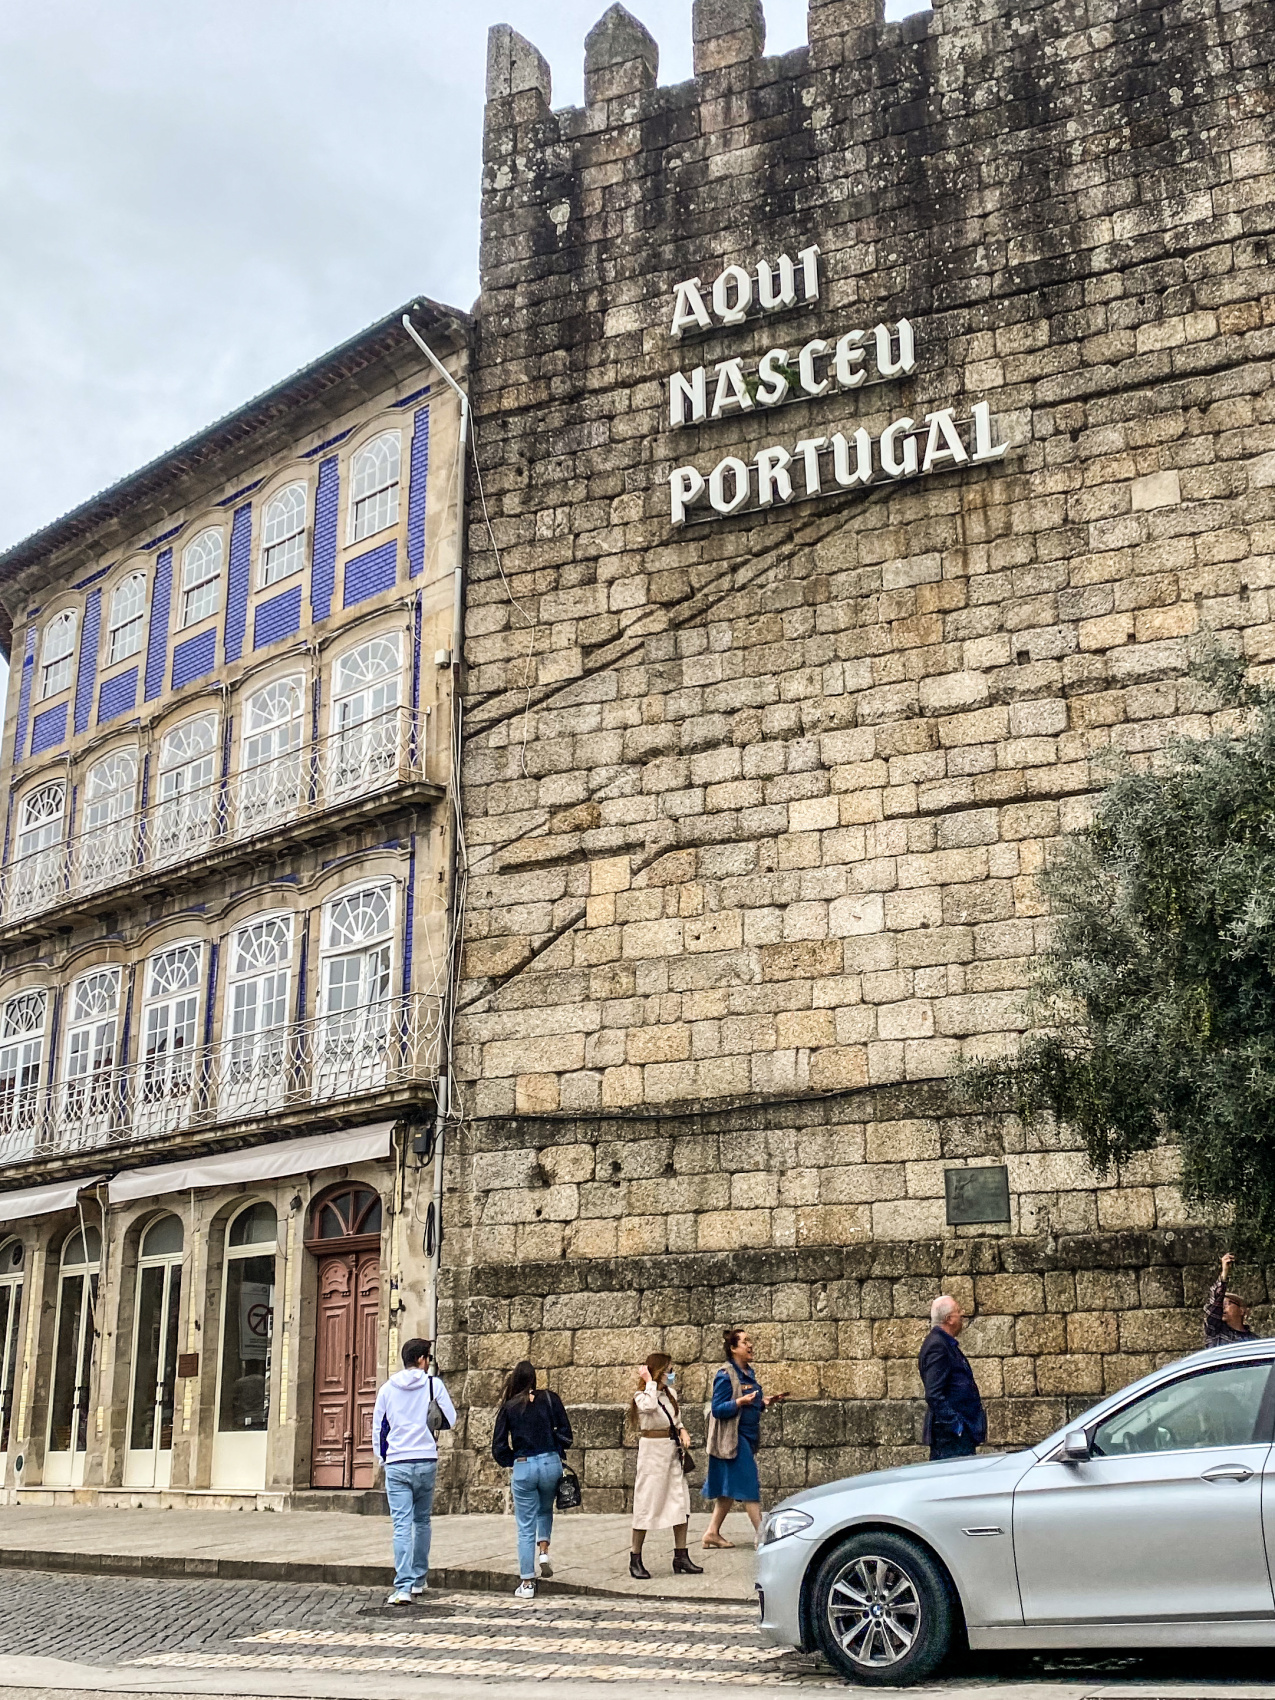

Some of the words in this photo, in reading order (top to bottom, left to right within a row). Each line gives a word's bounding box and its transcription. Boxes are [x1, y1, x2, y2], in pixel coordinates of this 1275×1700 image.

[670, 244, 821, 339] AQUI
[669, 317, 918, 428] NASCEU
[668, 400, 1011, 525] PORTUGAL
